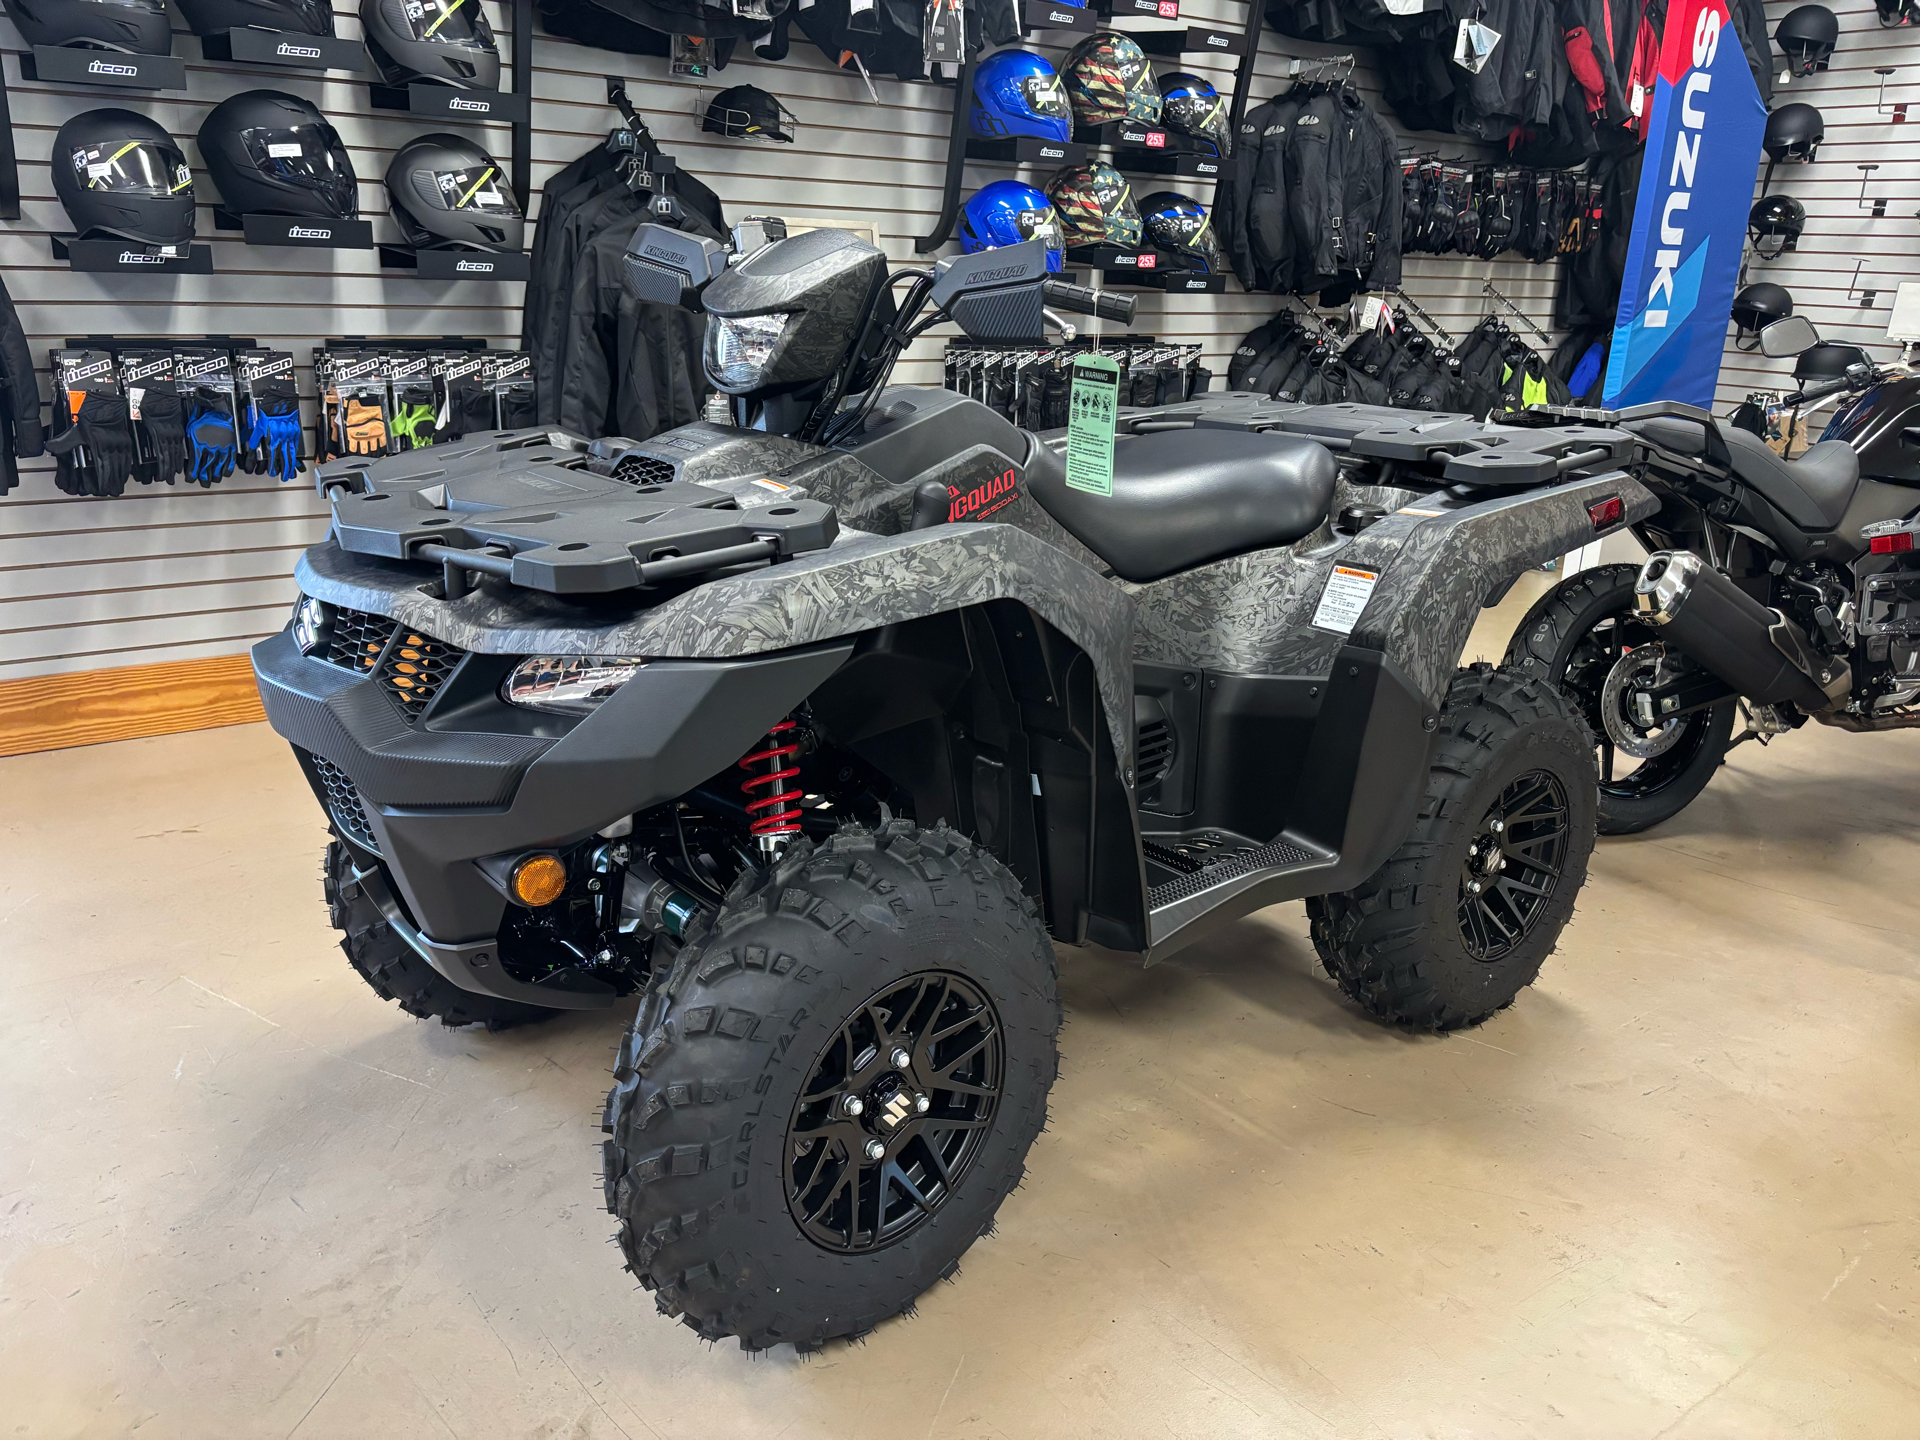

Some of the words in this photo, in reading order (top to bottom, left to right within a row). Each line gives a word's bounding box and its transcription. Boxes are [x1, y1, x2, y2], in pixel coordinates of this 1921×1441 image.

[1643, 7, 1721, 328] SUZUKI
[644, 245, 687, 264] KINGQUAD
[965, 264, 1028, 285] KINGQUAD
[1085, 370, 1109, 381] WARNING
[948, 469, 1015, 523] GQUAD
[1347, 570, 1367, 579] WARNING
[731, 1007, 811, 1190] CARLSTAR
